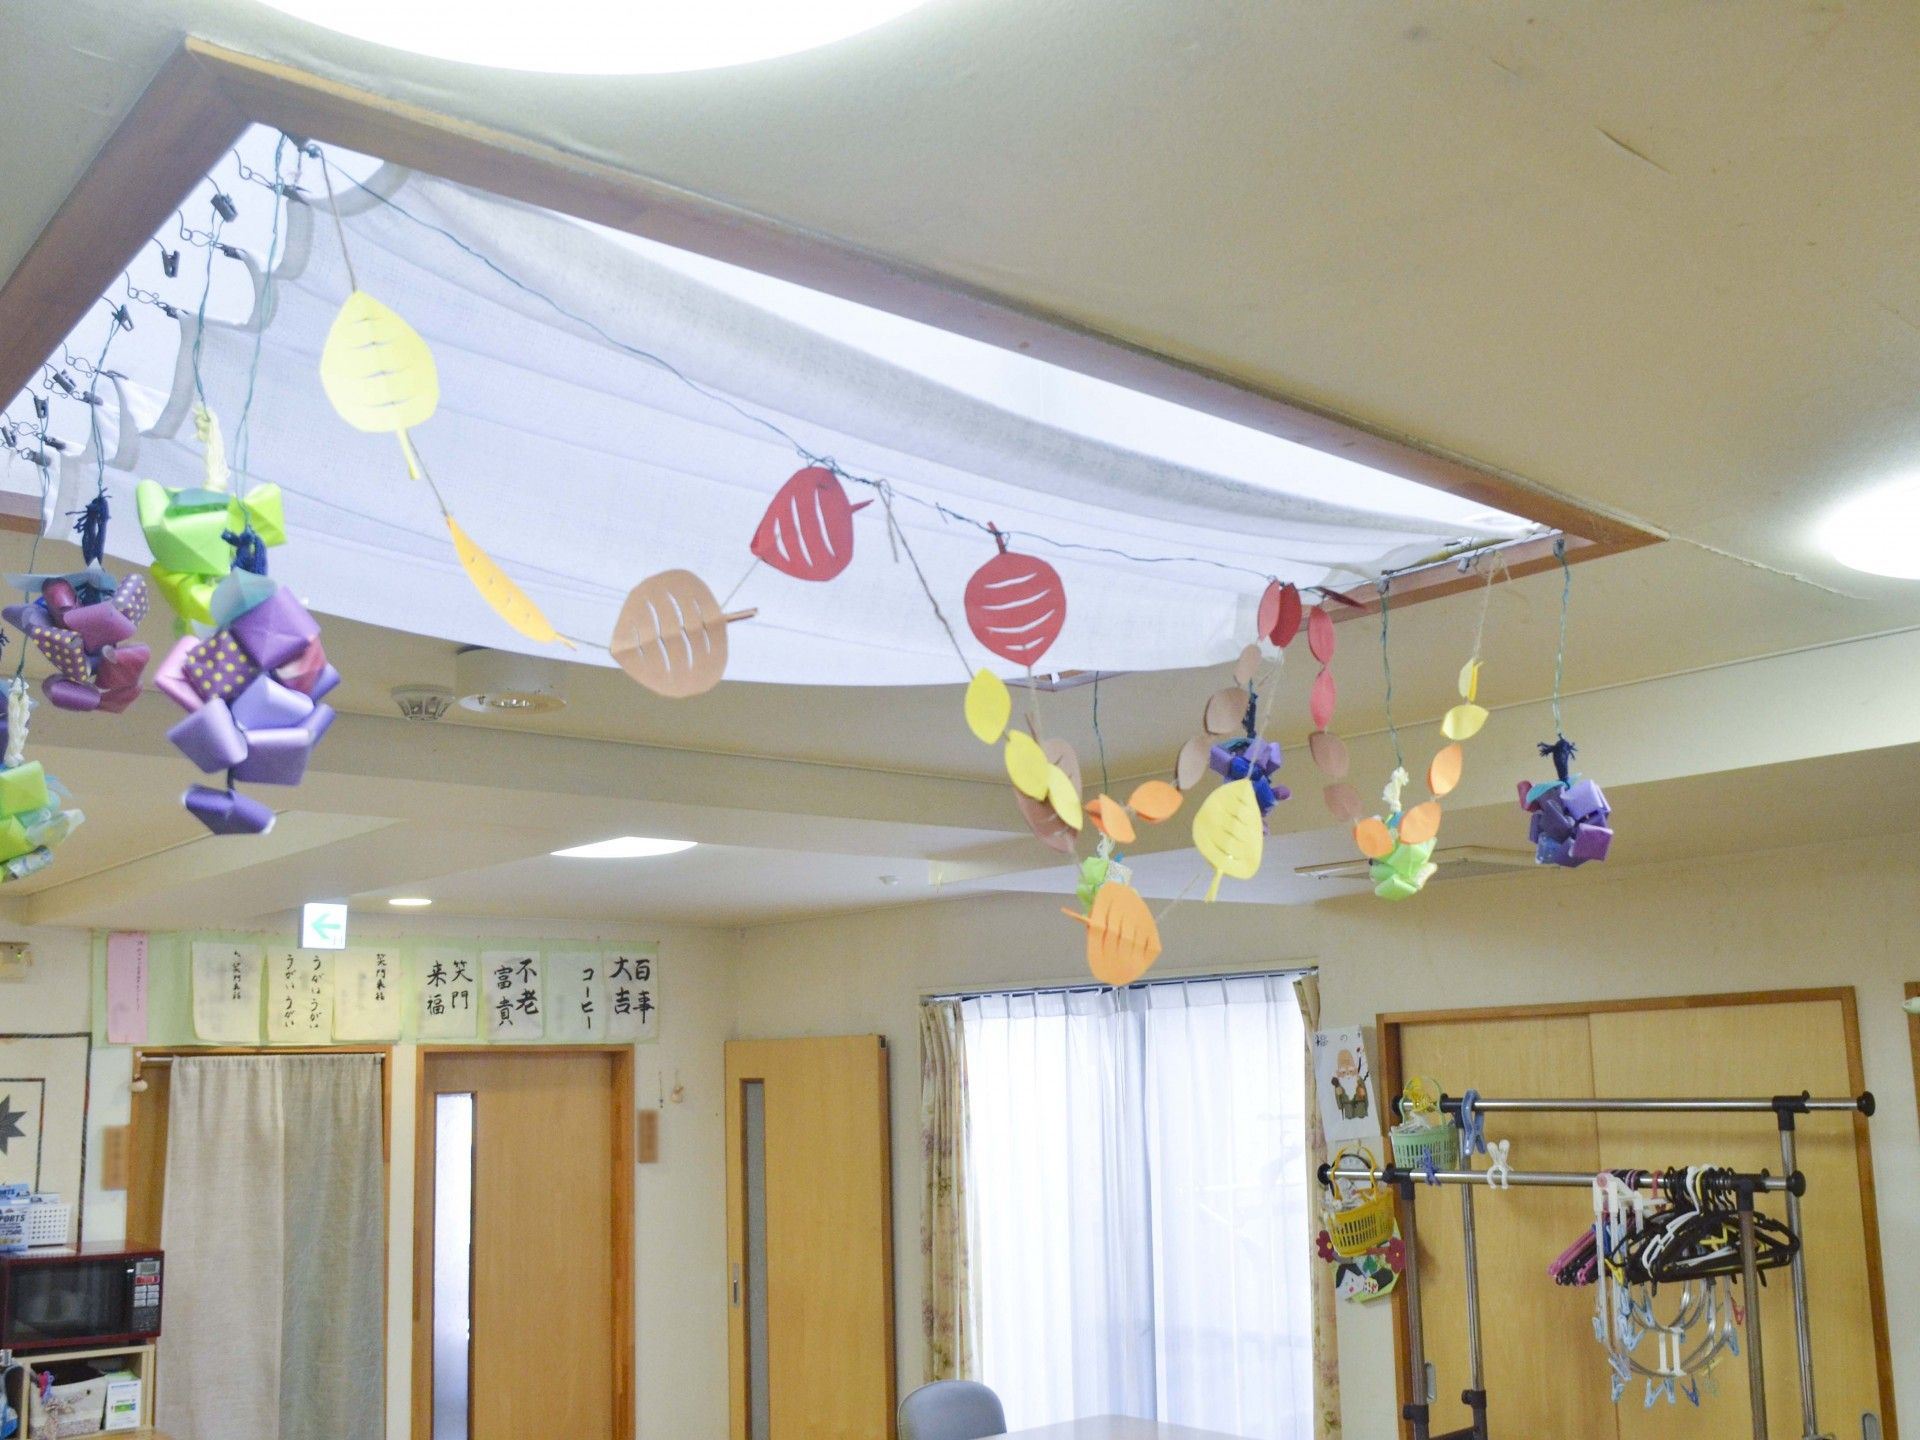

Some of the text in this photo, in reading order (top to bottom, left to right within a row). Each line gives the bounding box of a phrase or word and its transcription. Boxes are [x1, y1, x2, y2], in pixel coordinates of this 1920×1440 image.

[426, 960, 447, 1015] 来福
[450, 960, 473, 1010] 笑門
[494, 965, 514, 1027] 富貴
[515, 958, 540, 1015] 不老
[581, 967, 595, 1029] コーヒー
[608, 956, 632, 1015] 大吉
[632, 959, 655, 1024] 百事
